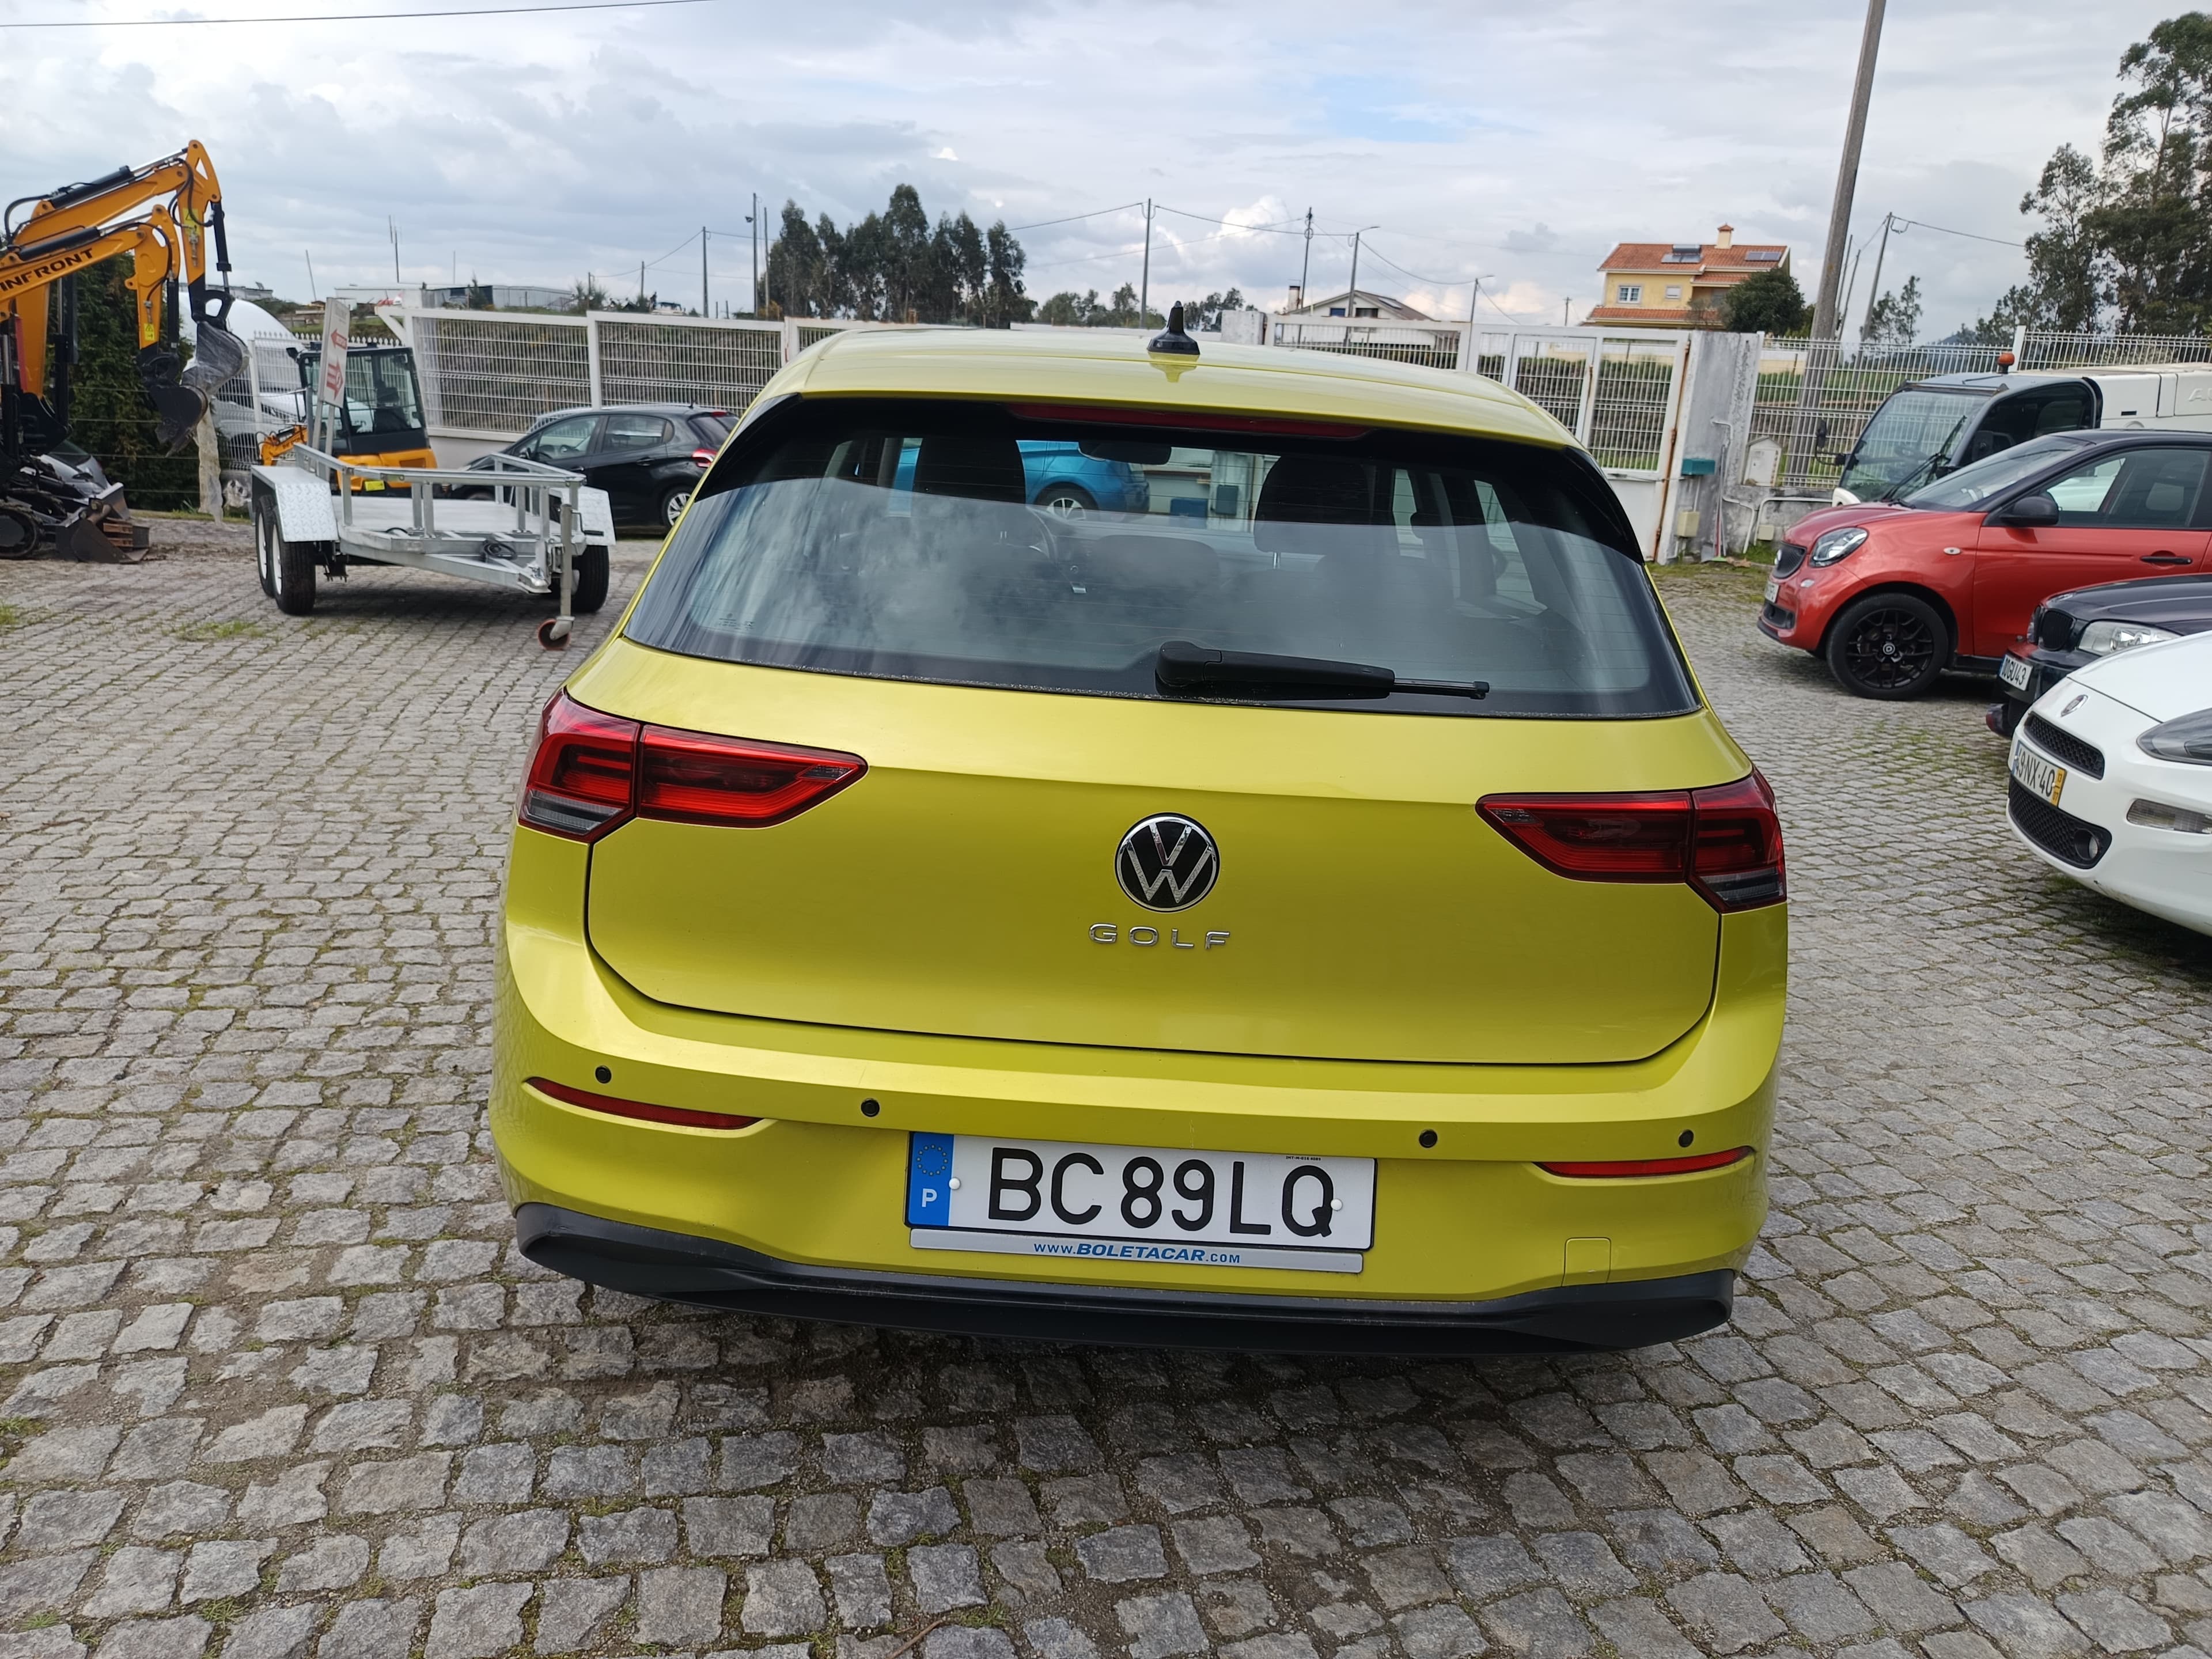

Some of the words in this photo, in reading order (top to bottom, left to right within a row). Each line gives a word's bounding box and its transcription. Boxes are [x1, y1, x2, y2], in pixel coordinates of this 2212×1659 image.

[0, 248, 93, 291] INFRONT
[1089, 923, 1230, 950] GOLF
[921, 1188, 938, 1207] P
